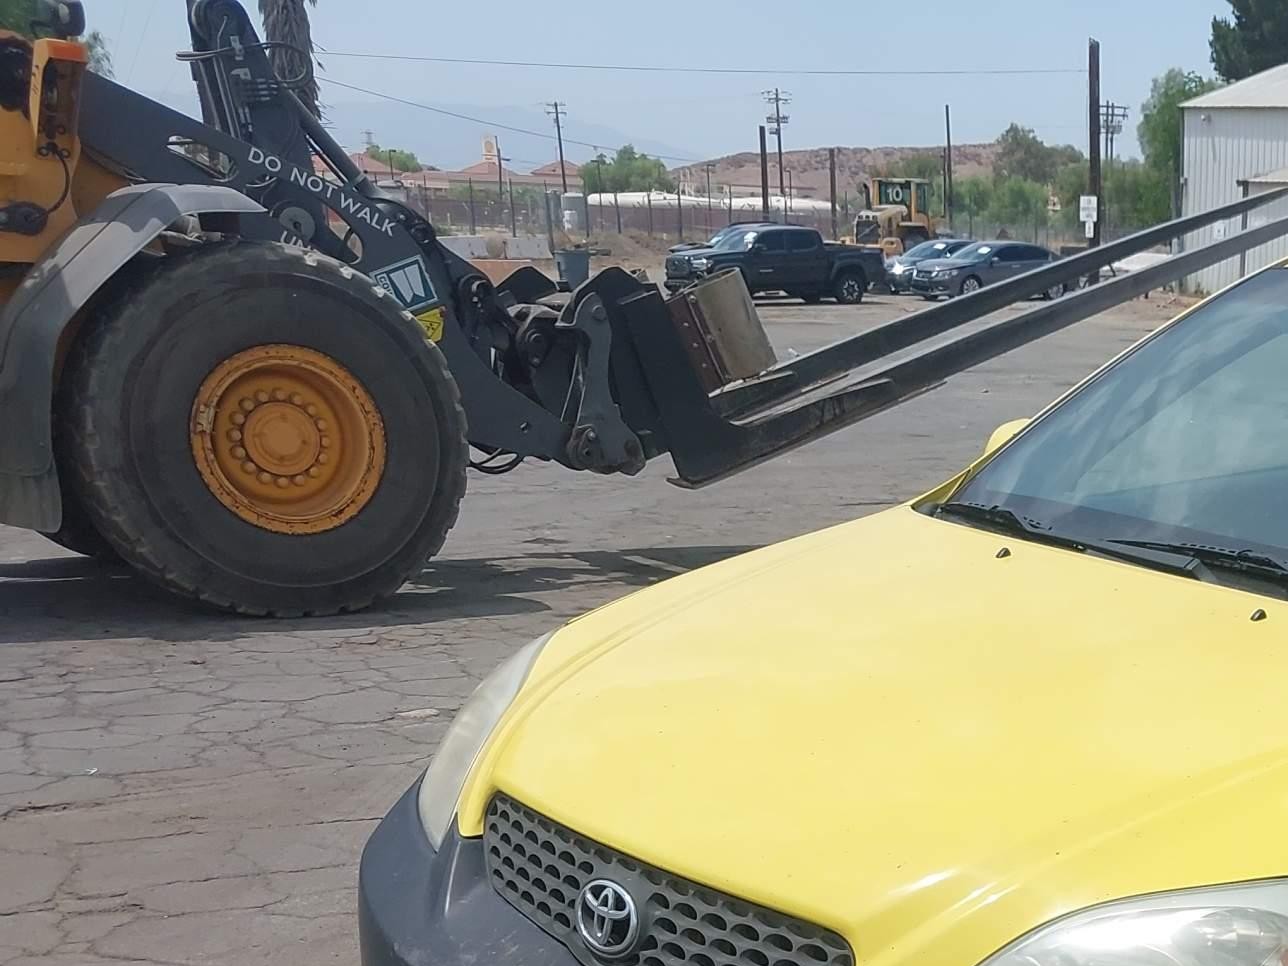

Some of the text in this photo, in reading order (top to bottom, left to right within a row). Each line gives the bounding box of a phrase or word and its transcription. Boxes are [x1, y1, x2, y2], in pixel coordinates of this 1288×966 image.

[248, 147, 397, 237] DO NOT WALK
[886, 185, 903, 202] 10
